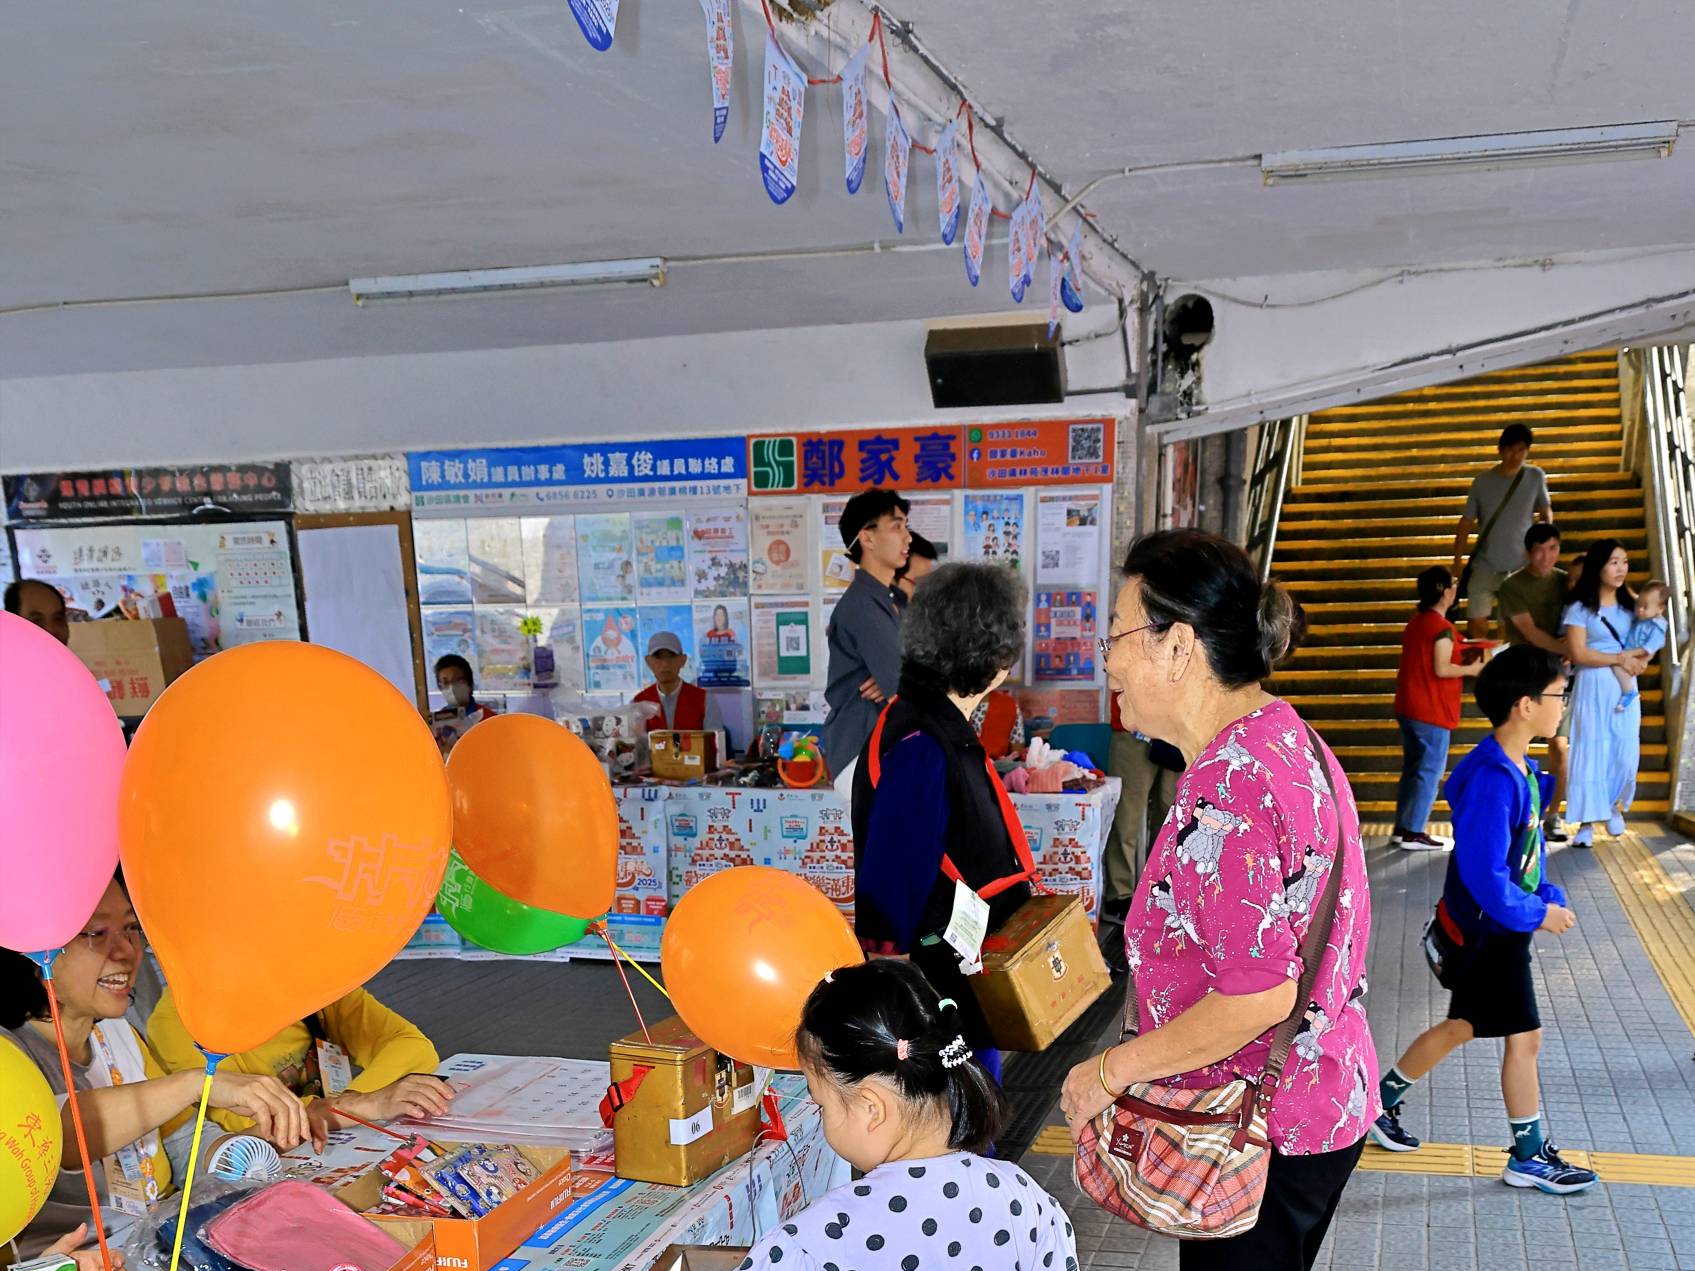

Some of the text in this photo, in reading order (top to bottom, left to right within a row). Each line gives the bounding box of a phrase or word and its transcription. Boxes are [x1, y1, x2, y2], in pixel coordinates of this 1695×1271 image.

[802, 432, 957, 488] 鄭家豪
[637, 877, 658, 887] 2025
[690, 1122, 701, 1136] 06
[550, 1186, 572, 1210] FUJIFILM
[436, 1256, 468, 1269] FUJIF
